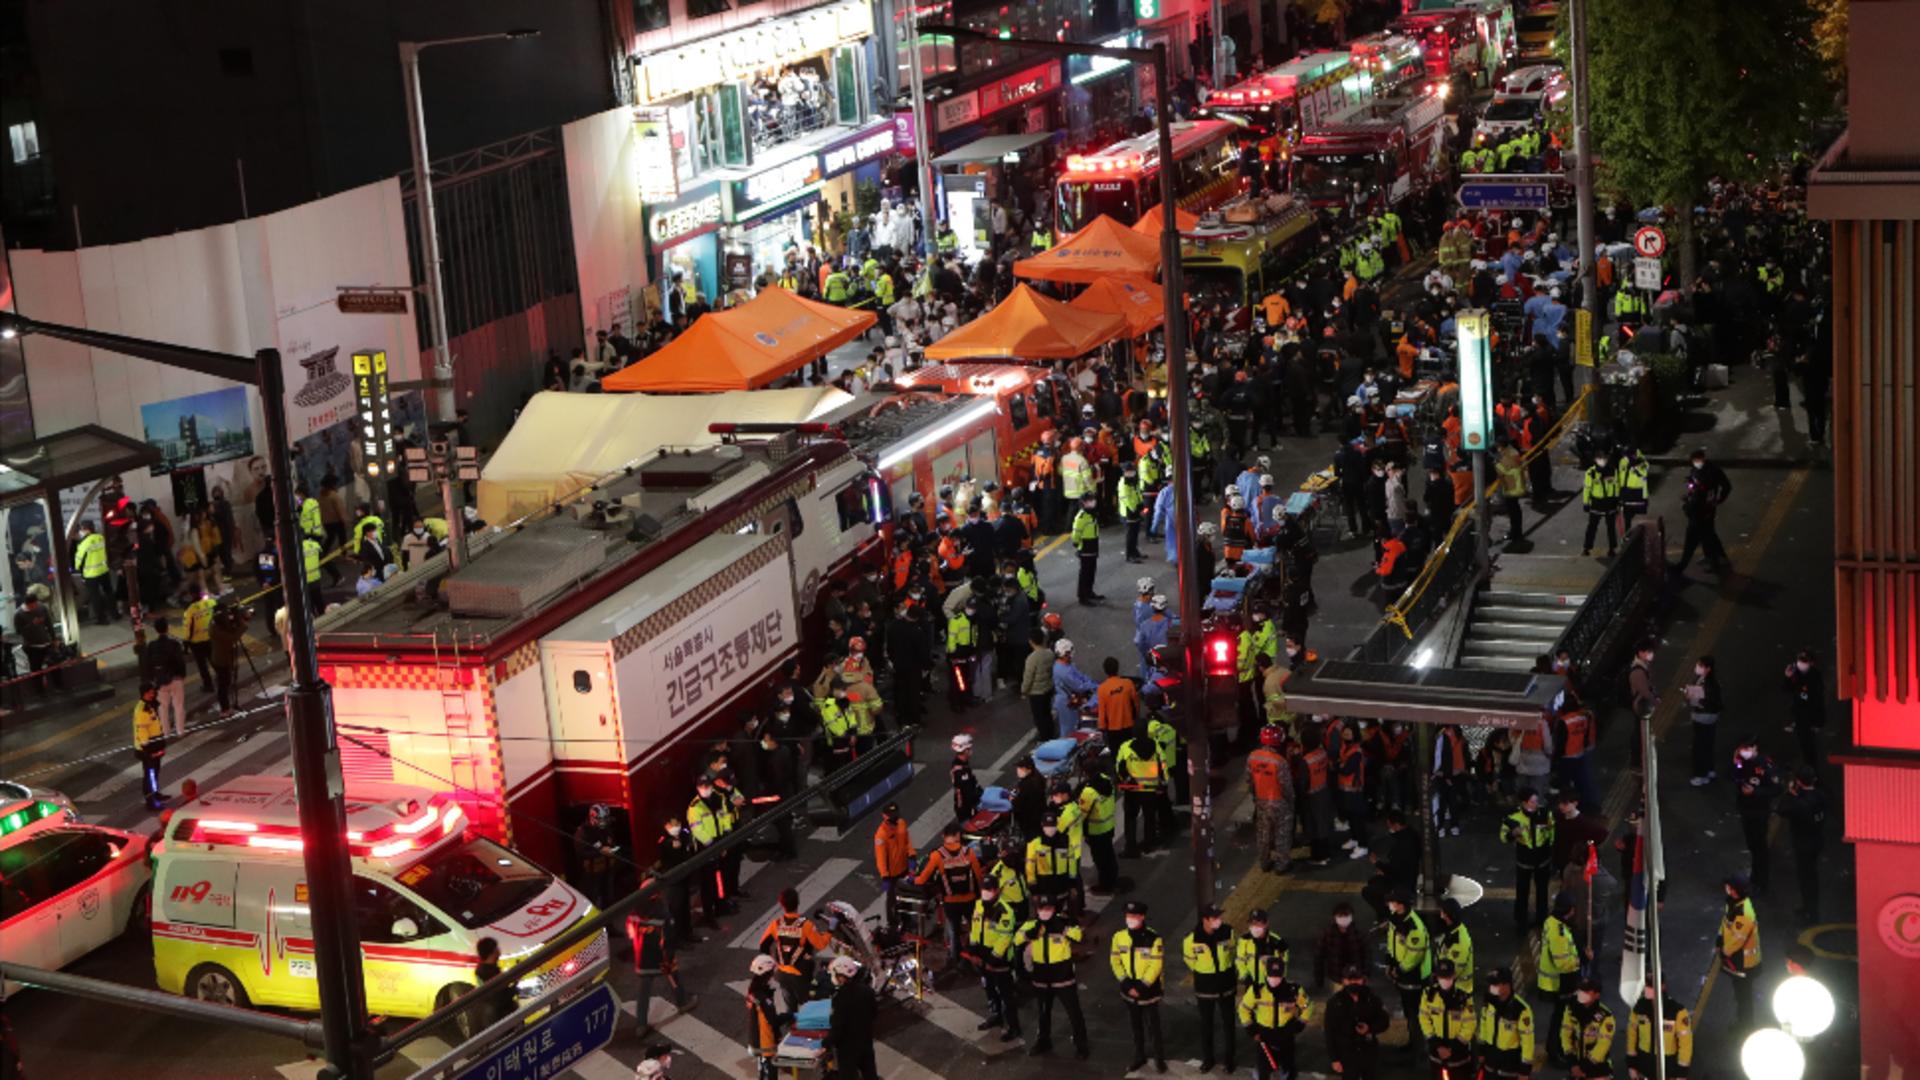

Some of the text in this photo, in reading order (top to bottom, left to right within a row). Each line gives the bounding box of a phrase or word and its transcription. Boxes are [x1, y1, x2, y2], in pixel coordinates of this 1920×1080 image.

[663, 624, 714, 671] 서울특별시
[666, 608, 783, 718] 긴급구조통제단
[170, 880, 212, 904] 119
[486, 1003, 610, 1080] 이태원로 177
